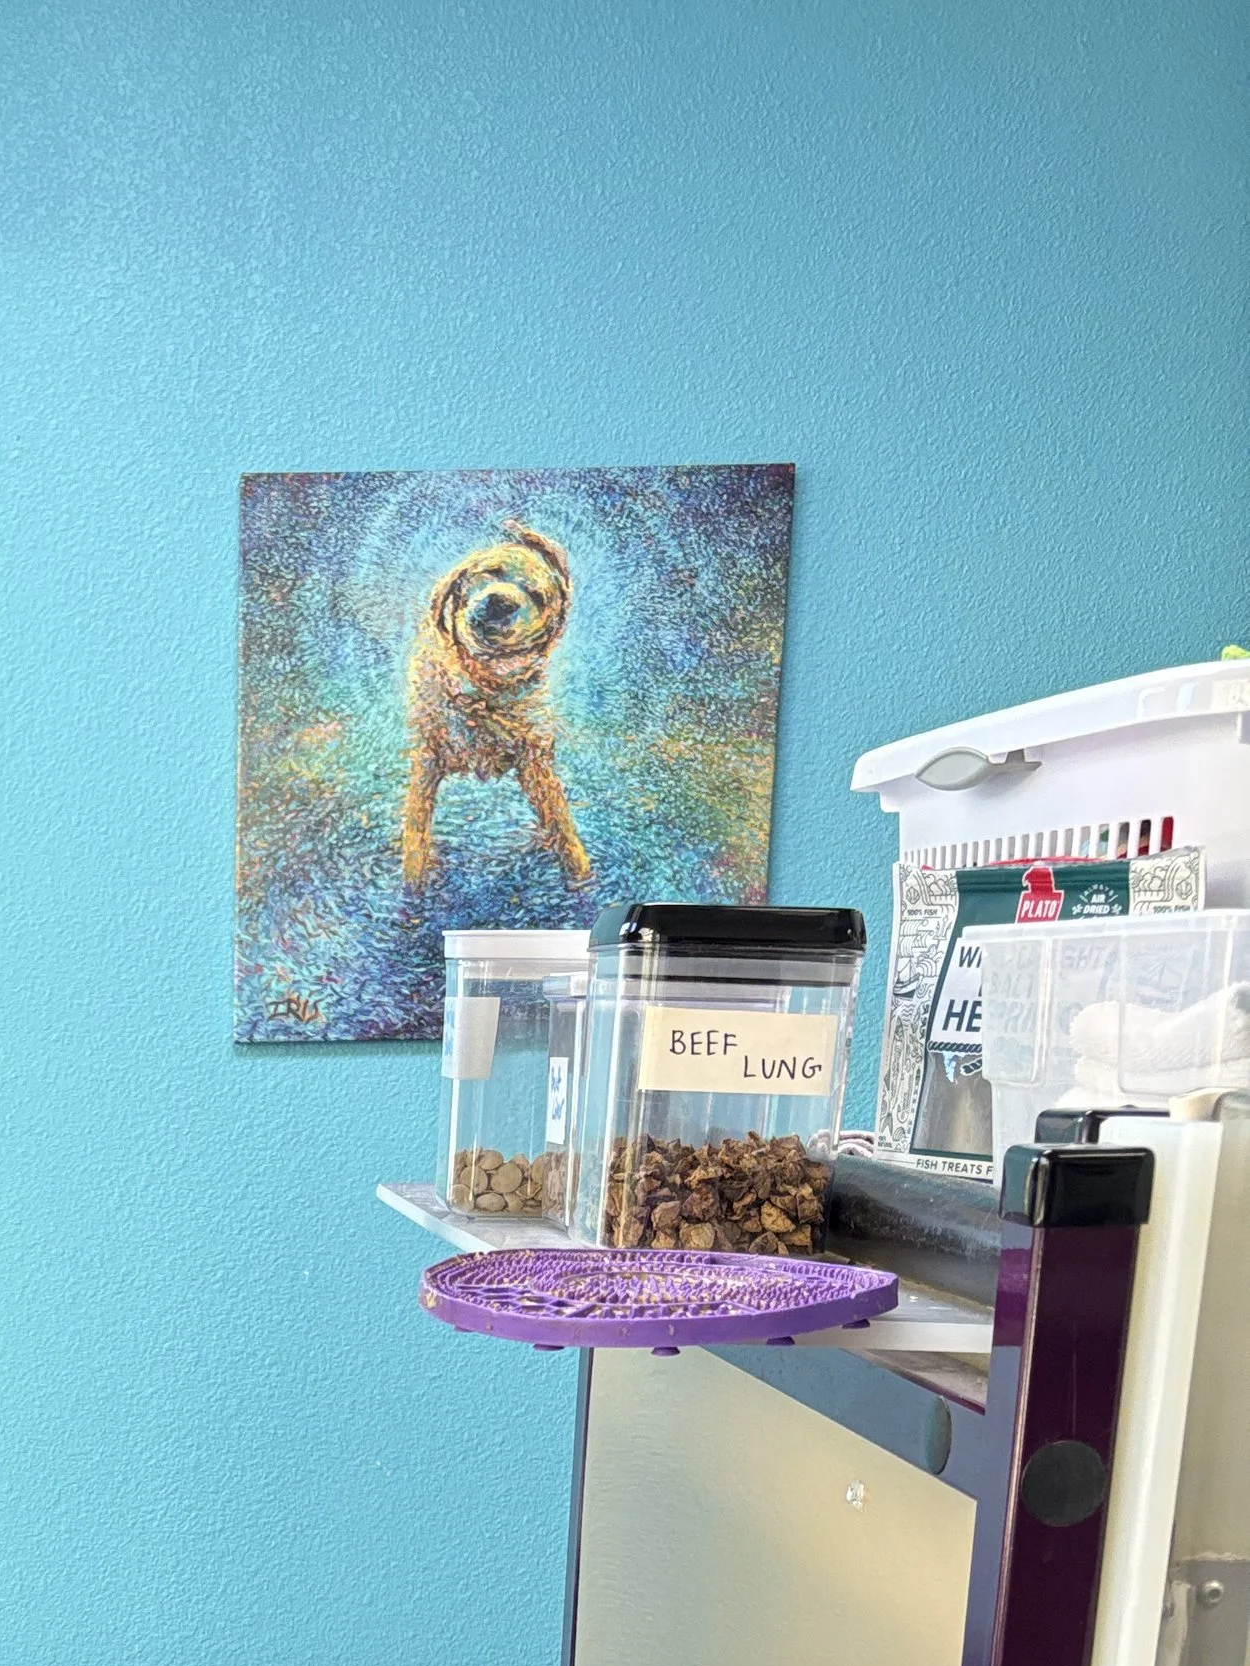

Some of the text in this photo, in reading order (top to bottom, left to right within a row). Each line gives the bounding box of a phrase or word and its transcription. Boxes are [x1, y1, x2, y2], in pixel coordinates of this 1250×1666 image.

[1091, 893, 1106, 903] AIR
[907, 908, 938, 917] 100% FISH
[1021, 900, 1058, 918] PLATO
[1082, 904, 1111, 915] DRIED
[669, 1029, 738, 1056] BEEF
[743, 1055, 822, 1080] LUNG
[915, 1158, 938, 1170] FISH
[942, 1160, 983, 1175] TREATS
